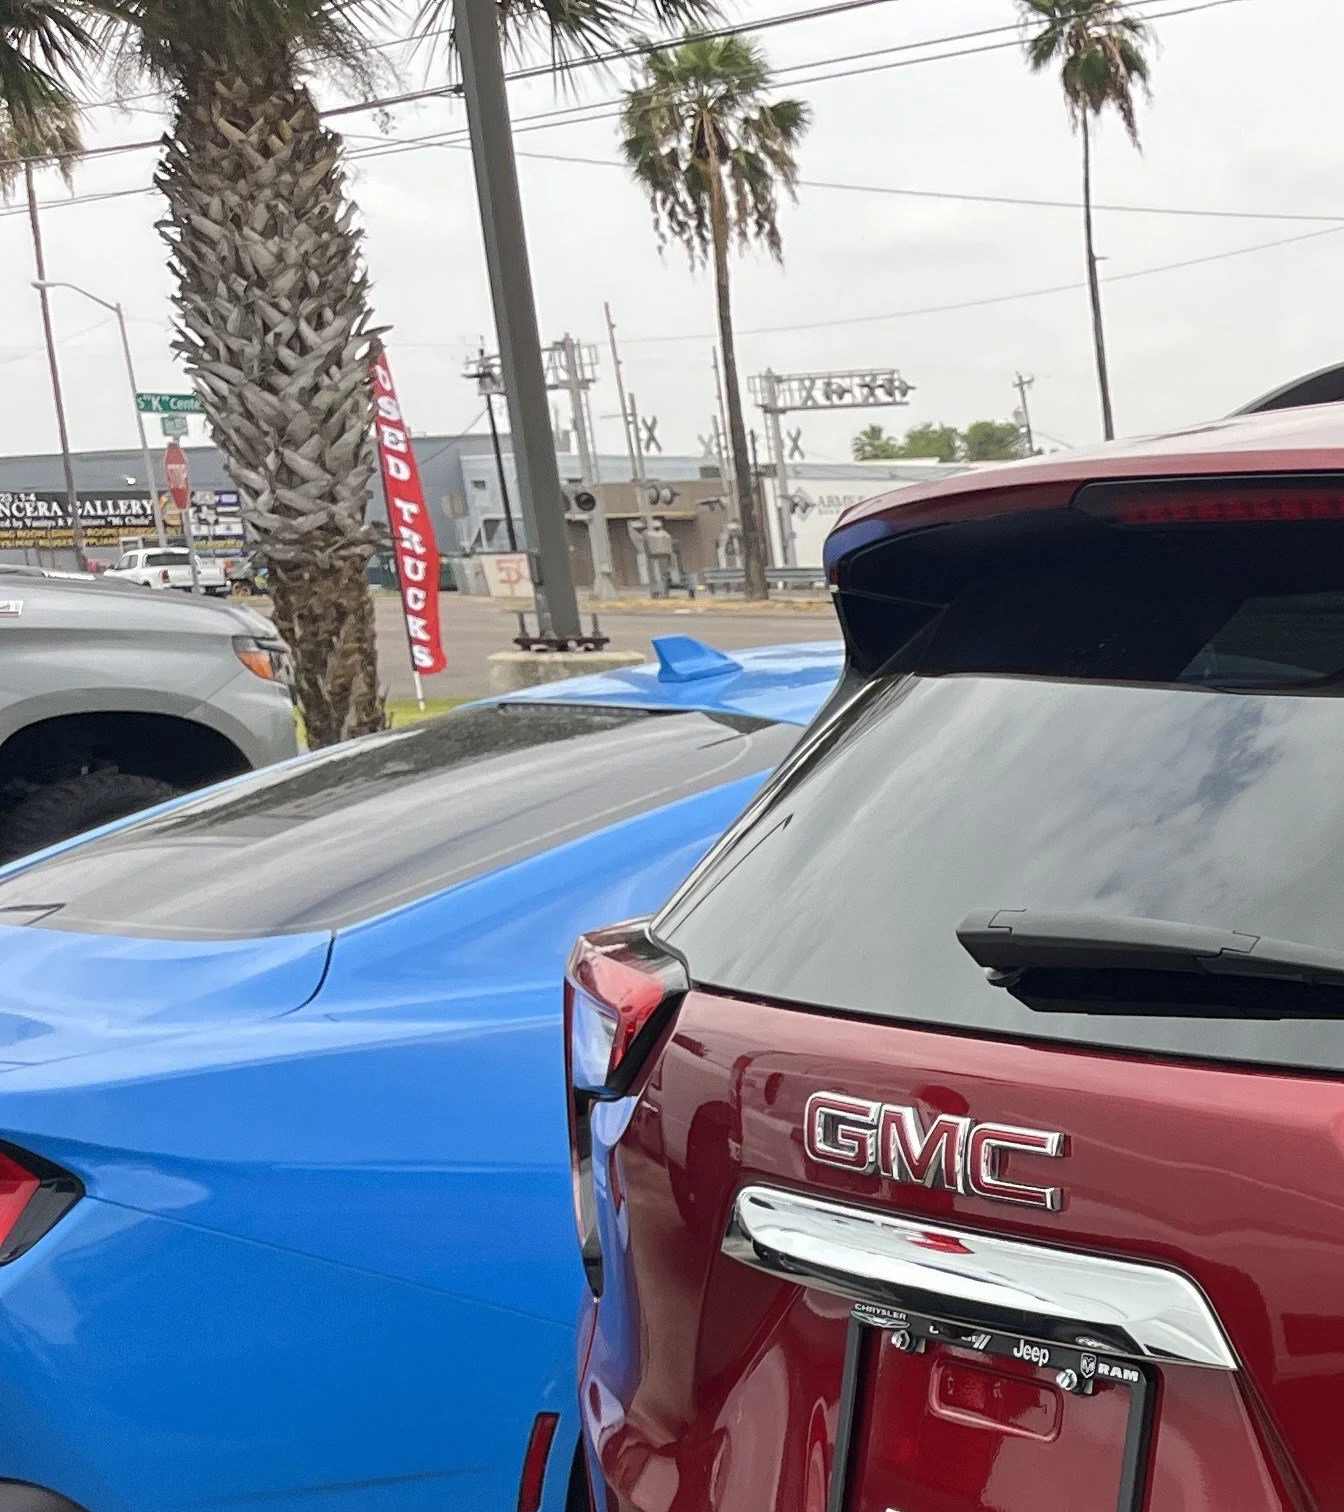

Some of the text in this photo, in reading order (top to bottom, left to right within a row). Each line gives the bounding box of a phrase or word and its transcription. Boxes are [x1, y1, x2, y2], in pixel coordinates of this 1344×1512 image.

[67, 500, 153, 516] GALLERY
[373, 364, 435, 668] USED TRUCKS
[803, 1090, 1065, 1213] GMC
[854, 1302, 908, 1321] CHRYSLER
[1013, 1339, 1050, 1367] Jeep
[1098, 1362, 1139, 1382] RAM
